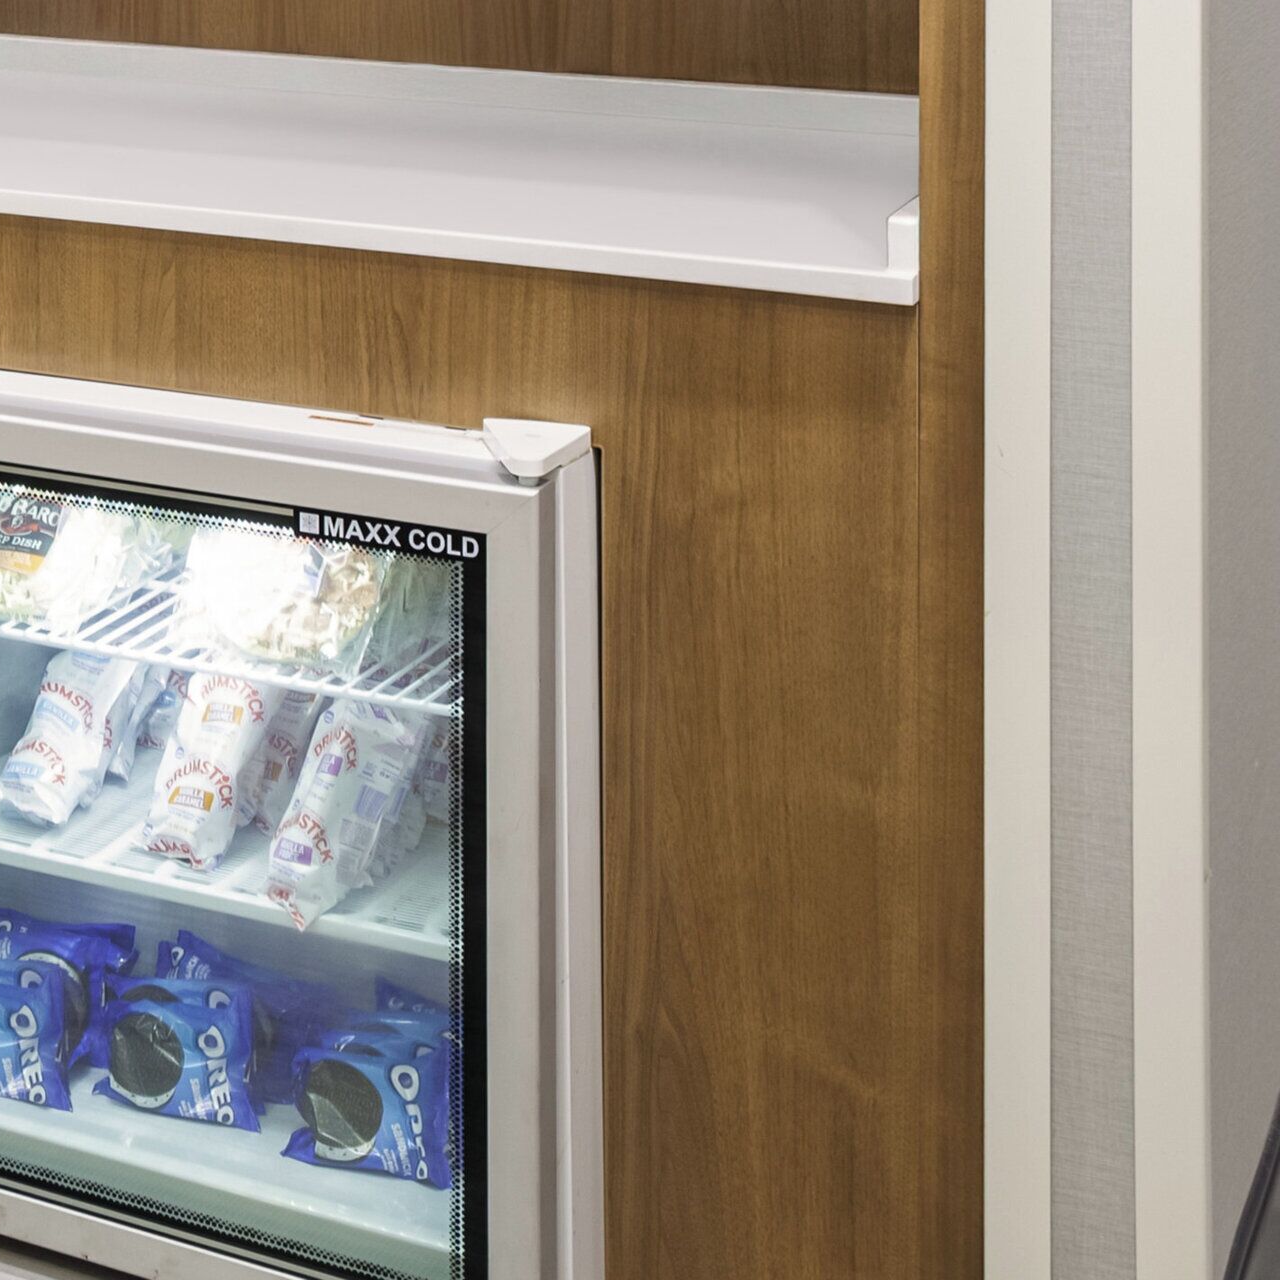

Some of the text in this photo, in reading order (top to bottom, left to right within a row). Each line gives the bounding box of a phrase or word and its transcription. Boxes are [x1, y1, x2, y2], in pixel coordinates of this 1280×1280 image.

[11, 535, 43, 552] DISH
[323, 515, 480, 558] MAXX COLD
[40, 681, 95, 735] RUMSTICK
[201, 673, 265, 723] RUMSTICK
[165, 758, 234, 810] DRUMSTICK
[10, 1004, 48, 1105] OREO
[197, 1025, 235, 1125] OREO
